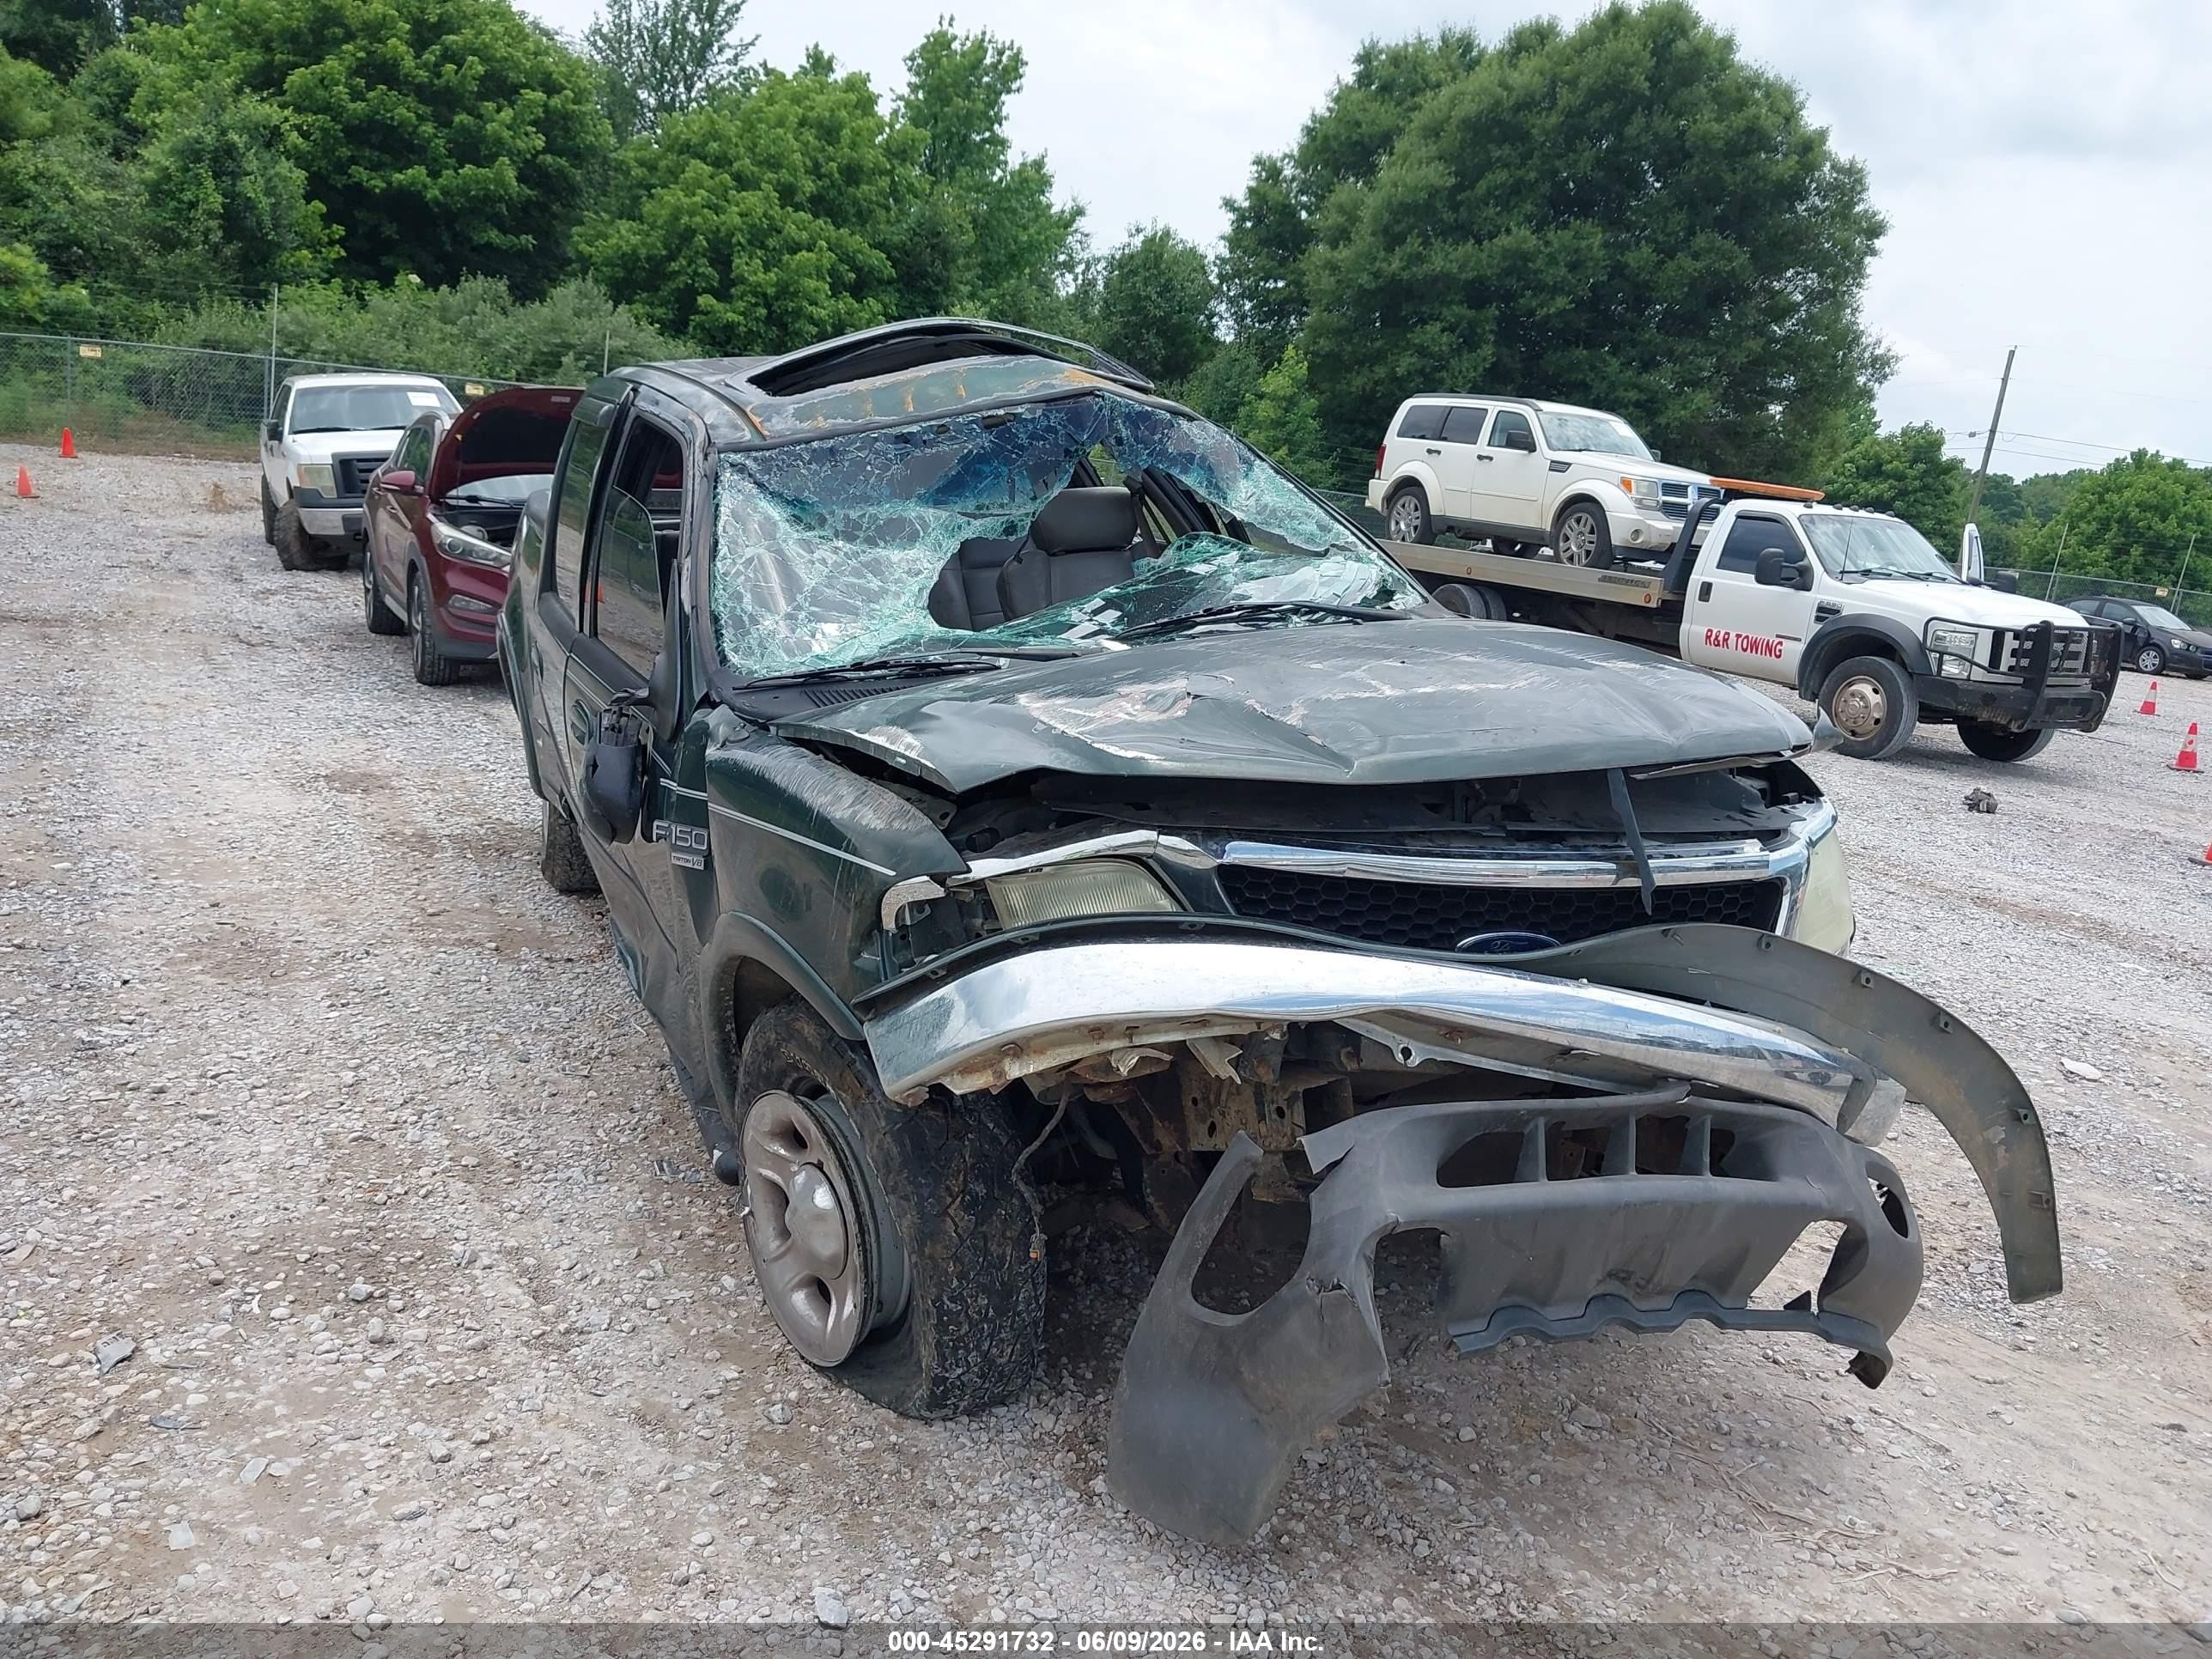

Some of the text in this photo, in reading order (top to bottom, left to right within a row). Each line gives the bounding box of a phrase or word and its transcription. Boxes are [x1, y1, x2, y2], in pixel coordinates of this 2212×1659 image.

[1705, 629, 1784, 659] R&R TOWING
[692, 857, 702, 866] V8
